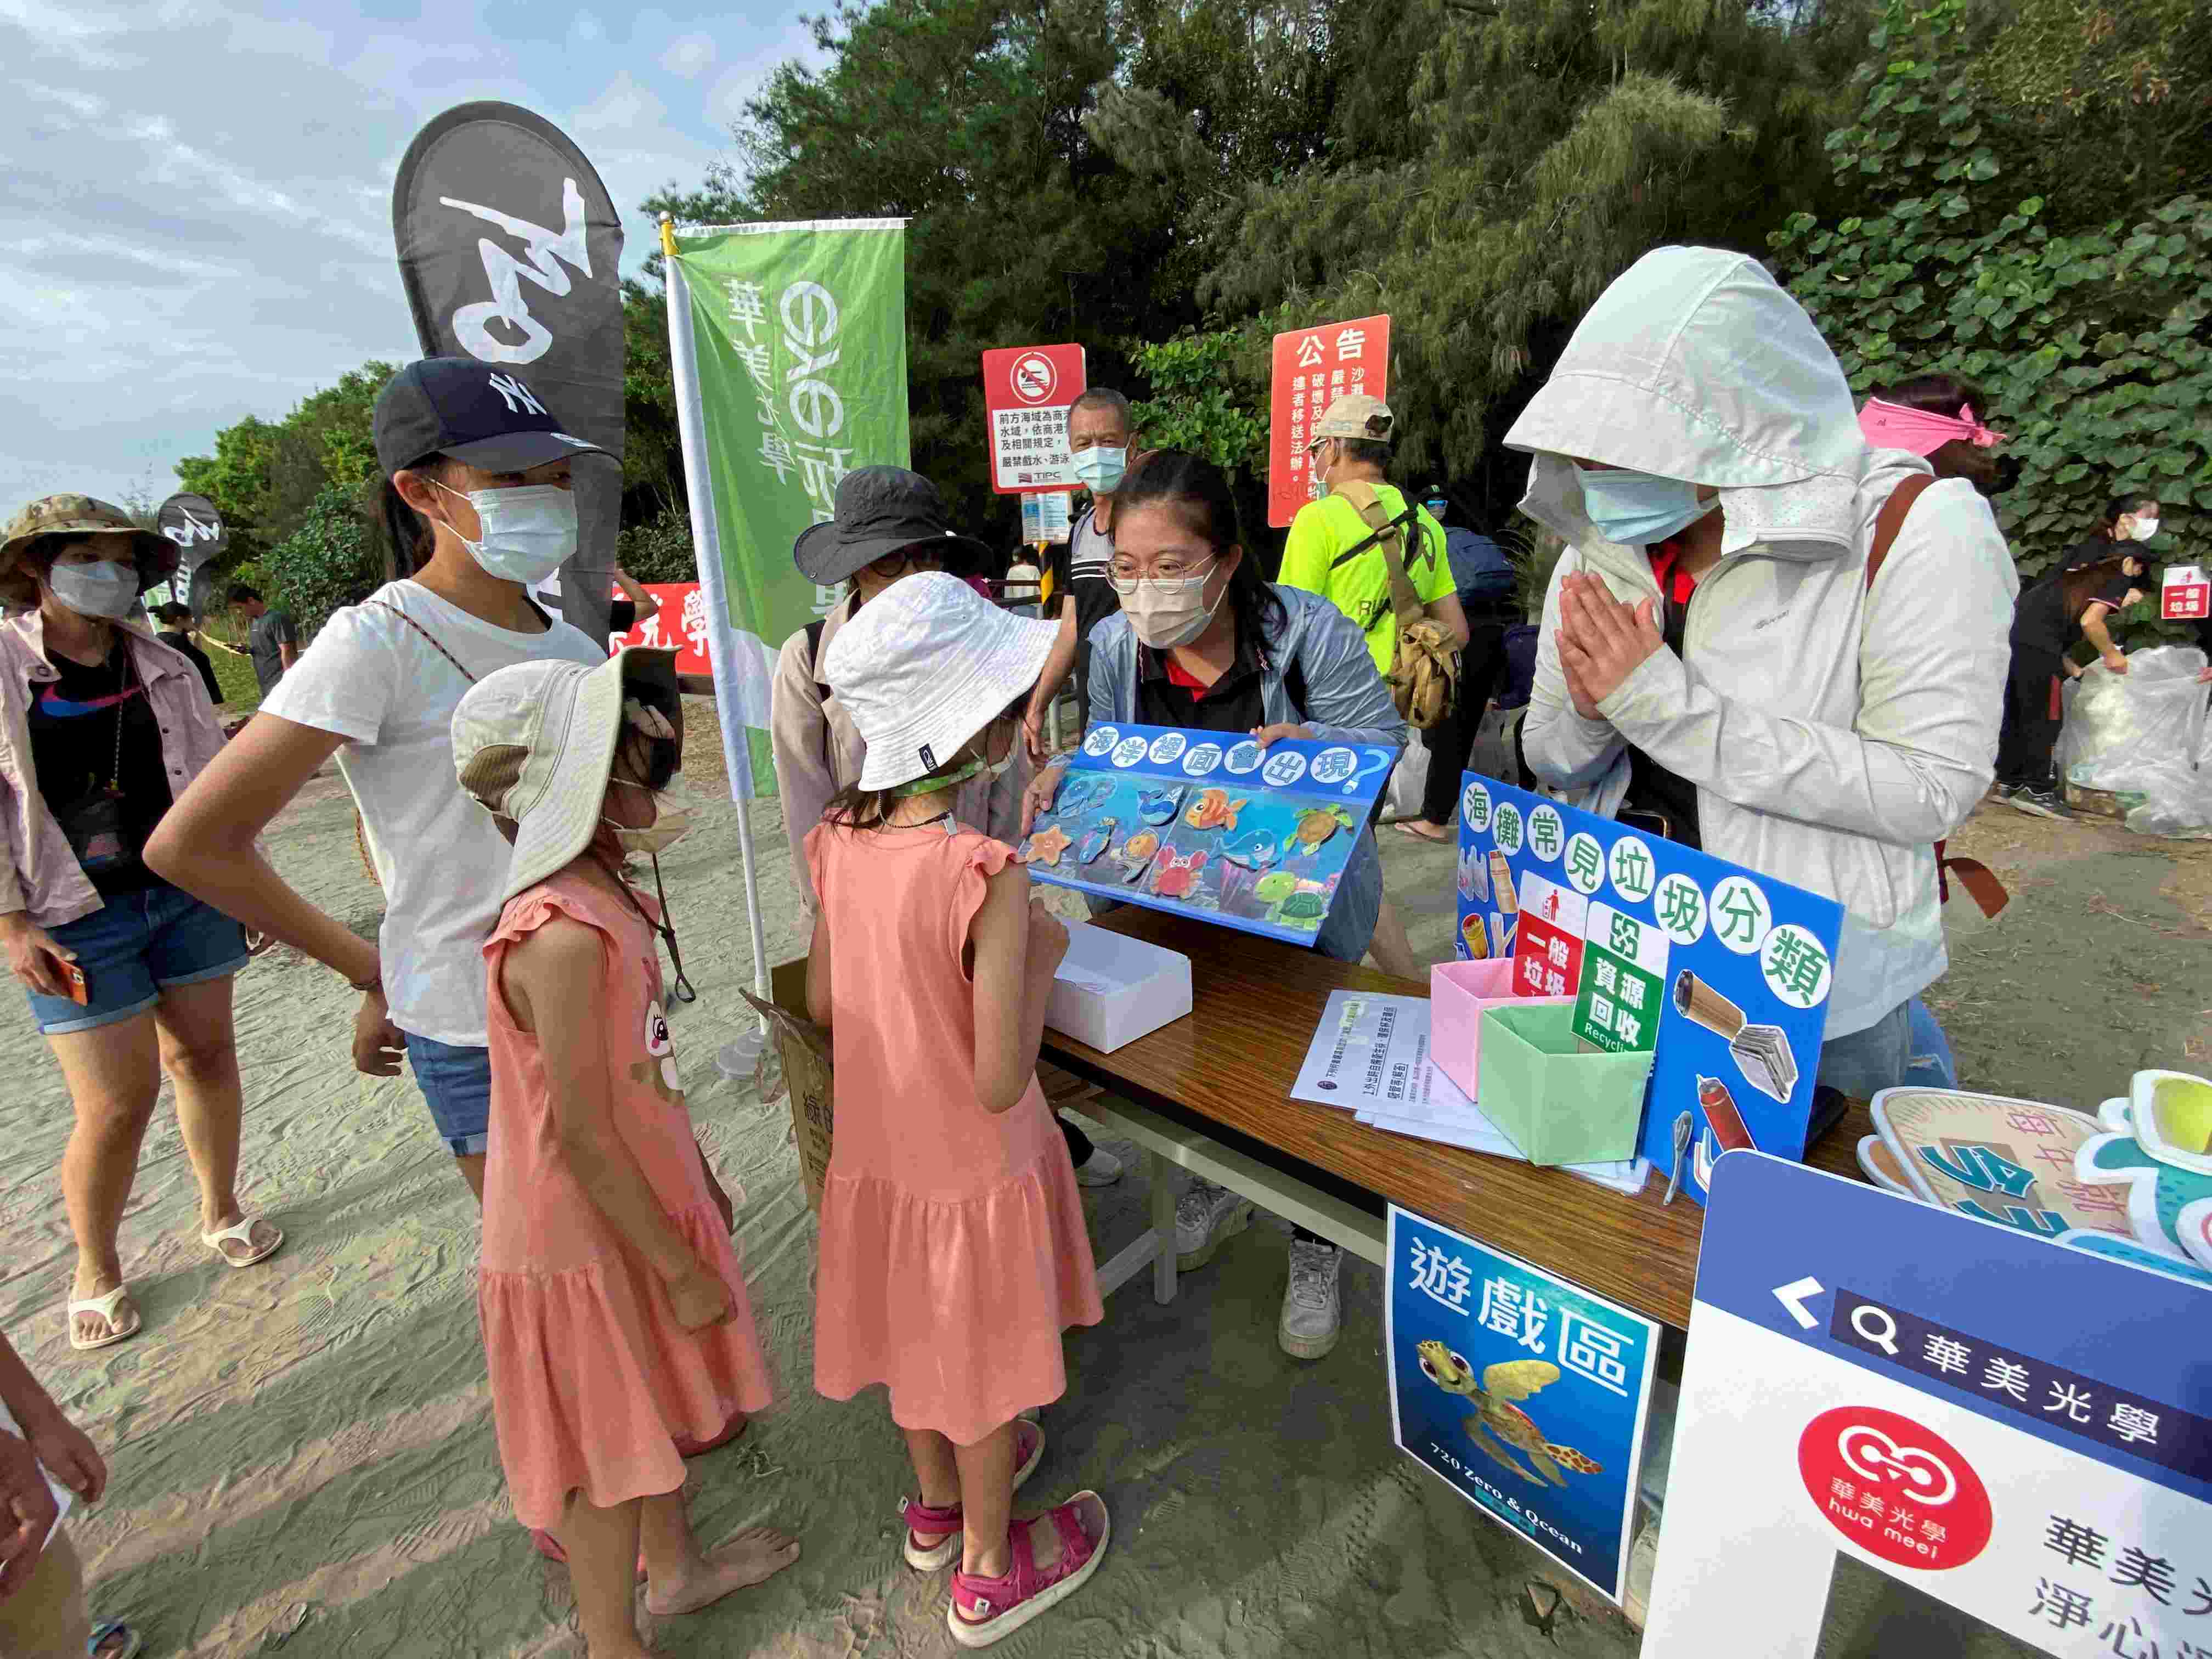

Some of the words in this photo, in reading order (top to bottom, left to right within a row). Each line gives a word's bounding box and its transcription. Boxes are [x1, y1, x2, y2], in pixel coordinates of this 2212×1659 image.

[1296, 329, 1365, 368] 公告
[489, 373, 548, 415] NY
[1001, 422, 1067, 437] 水域，依商港
[1527, 932, 1570, 970] 一般
[1523, 956, 1566, 997] 垃圾
[1594, 957, 1645, 1011] 資源
[1584, 1022, 1628, 1053] Recycli
[1588, 993, 1641, 1048] 回收
[1408, 1237, 1634, 1398] 遊戲區
[1923, 1333, 2160, 1445] 華美光學
[1430, 1442, 1460, 1470] 720
[1464, 1466, 1502, 1499] Zero
[1506, 1497, 1521, 1513] &
[1829, 1497, 1874, 1529] hwa
[1830, 1476, 1947, 1543] 華美光學
